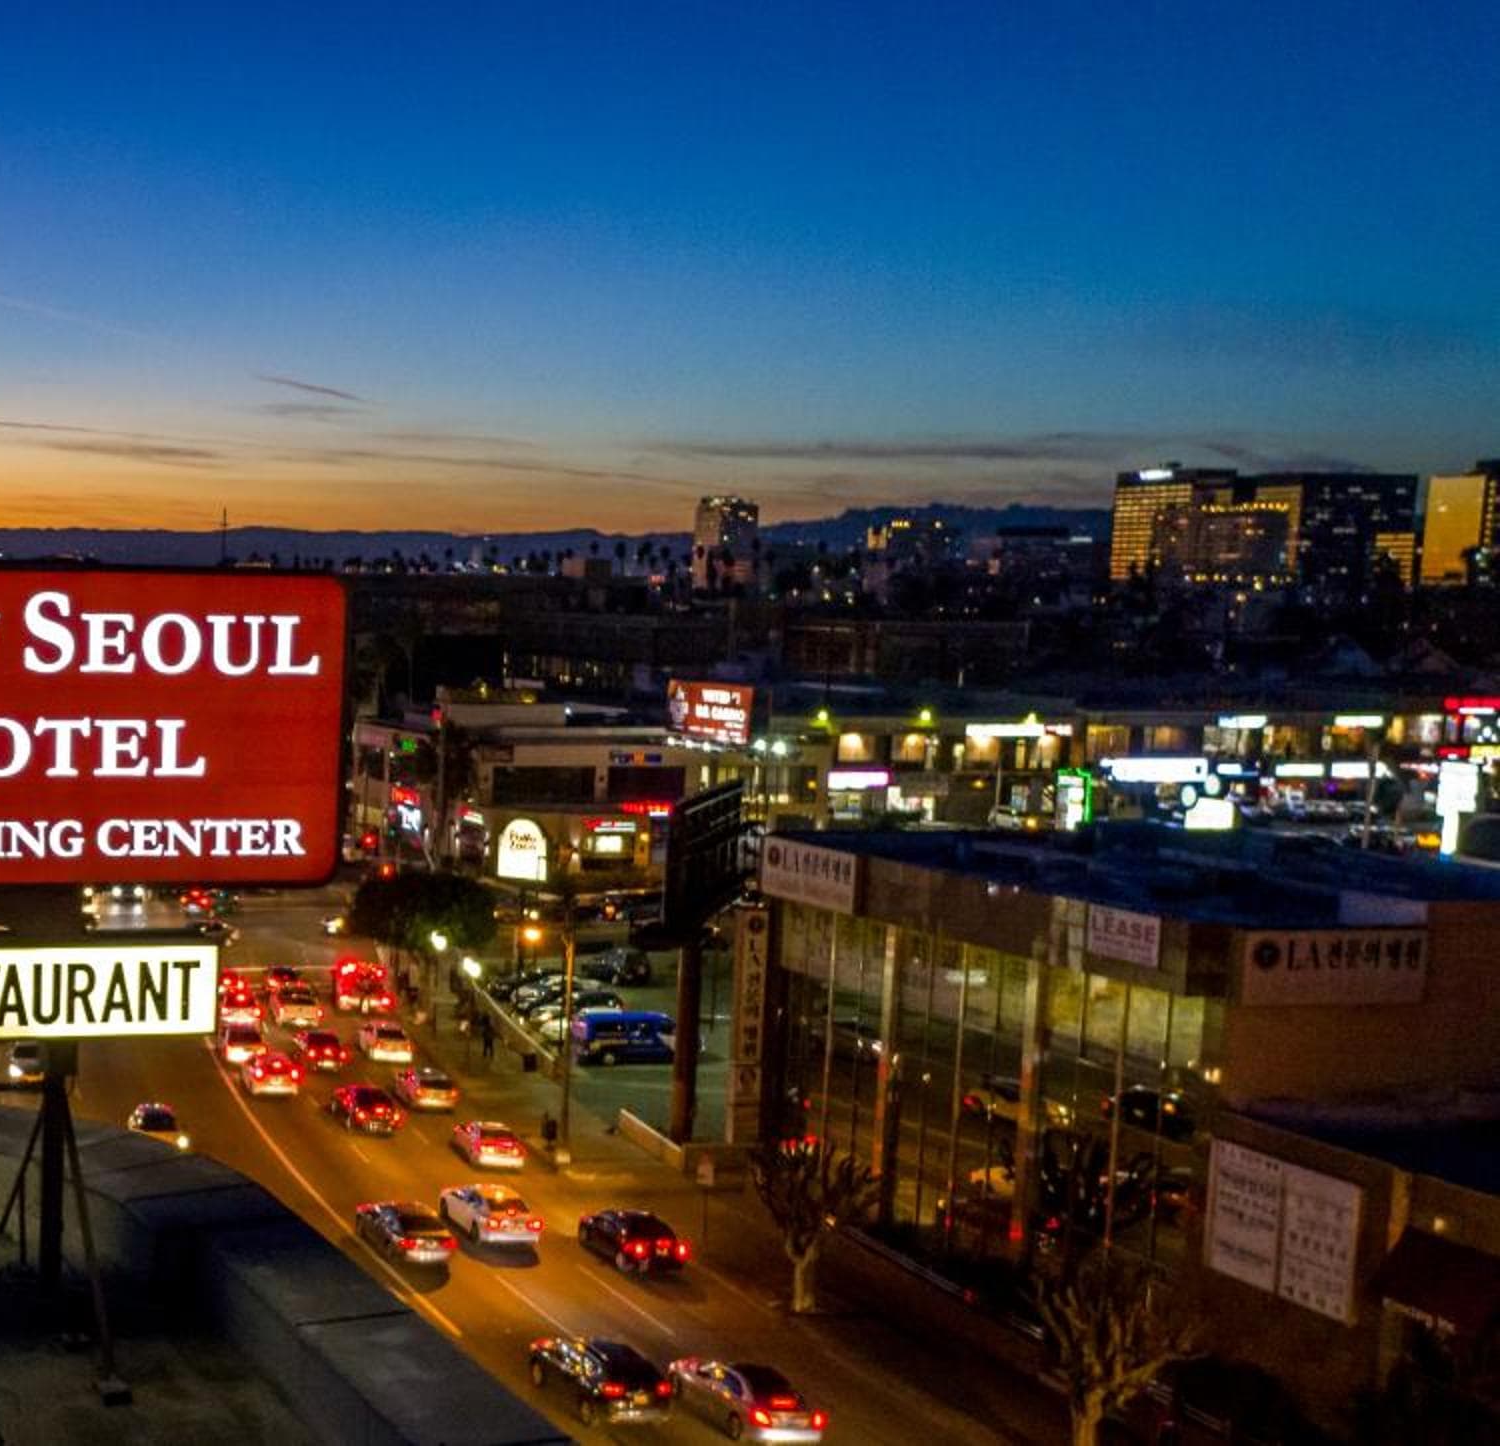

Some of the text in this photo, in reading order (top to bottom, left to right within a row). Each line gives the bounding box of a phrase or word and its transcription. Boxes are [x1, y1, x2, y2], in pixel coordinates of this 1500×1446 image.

[23, 591, 320, 676] SEOUL
[96, 818, 306, 858] CENTER
[1091, 914, 1157, 945] LEASE
